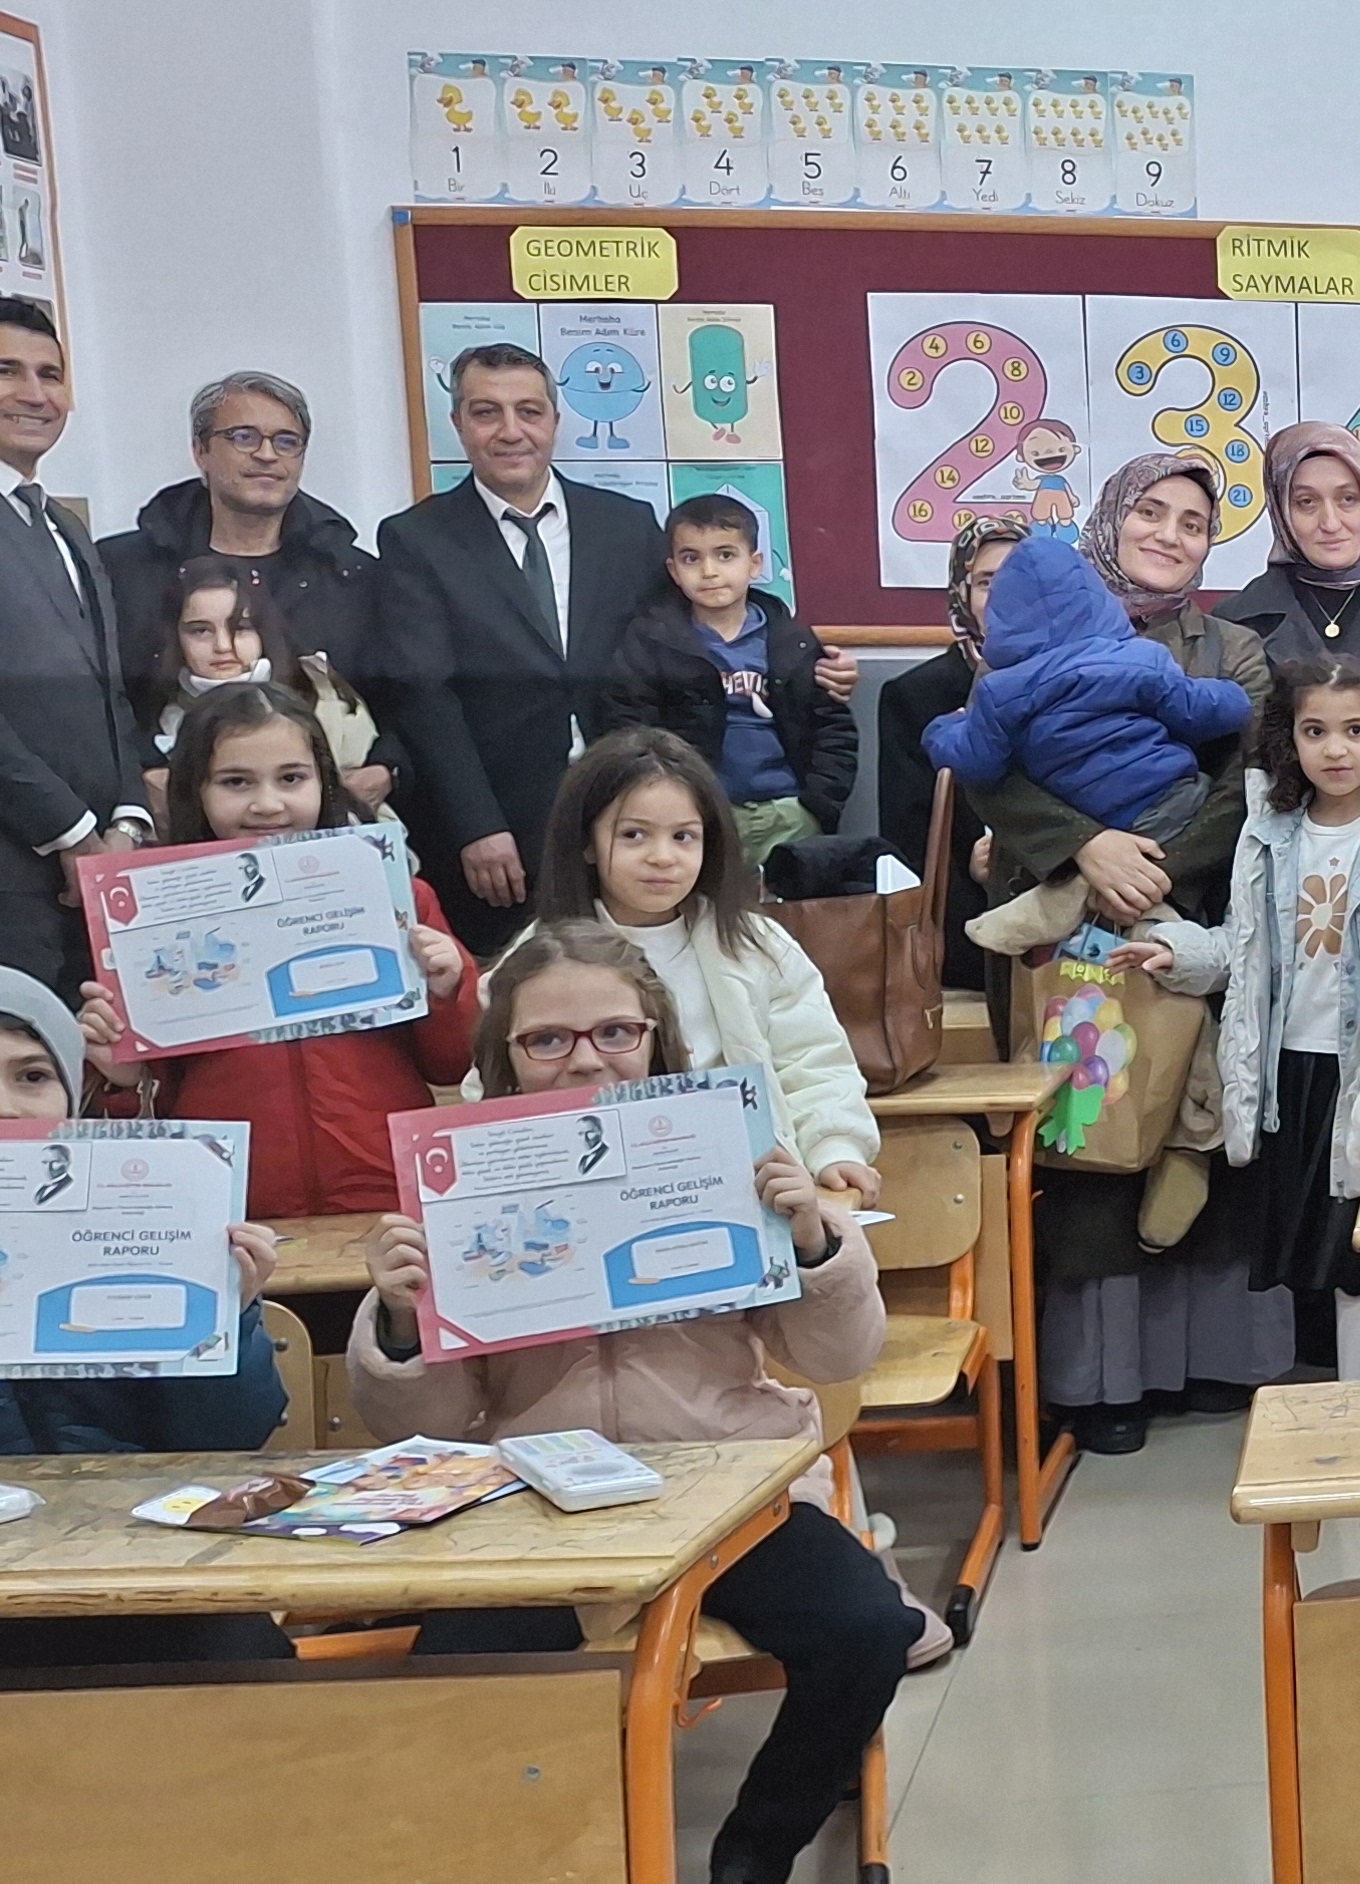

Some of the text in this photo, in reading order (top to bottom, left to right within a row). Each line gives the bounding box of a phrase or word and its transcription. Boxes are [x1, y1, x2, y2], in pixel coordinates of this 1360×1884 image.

[452, 146, 461, 173] 1
[539, 149, 559, 176] 2
[629, 152, 647, 178] 3
[713, 149, 734, 176] 4
[804, 152, 823, 180] 5
[890, 155, 908, 182] 6
[975, 159, 993, 186] 7
[1060, 159, 1077, 186] 8
[1145, 161, 1163, 187] 9
[448, 177, 466, 193] Bir
[526, 236, 661, 259] GEOMETRİK
[1231, 233, 1310, 260] RİTMİK
[528, 269, 631, 293] CİSİMLER
[1232, 273, 1355, 296] SAYMALAR
[928, 337, 940, 354] 4
[973, 334, 985, 351] 6
[1170, 333, 1181, 349] 6
[1219, 346, 1231, 363] 9
[1010, 361, 1022, 378] 8
[1134, 366, 1146, 382] 3
[906, 370, 919, 387] 2
[1222, 392, 1239, 406] 12
[1002, 405, 1021, 421] 10
[1188, 419, 1205, 434] 15
[974, 438, 991, 455] 12
[1230, 443, 1246, 458] 18
[939, 468, 957, 485] 14
[1232, 489, 1249, 503] 21
[911, 503, 929, 519] 16
[619, 1174, 724, 1202] ÖĞRENCİ GELİŞİM
[649, 1194, 699, 1211] RAPORU
[71, 1228, 192, 1244] ÖĞRENCİ GELİŞİM
[102, 1245, 160, 1257] RAPORU
